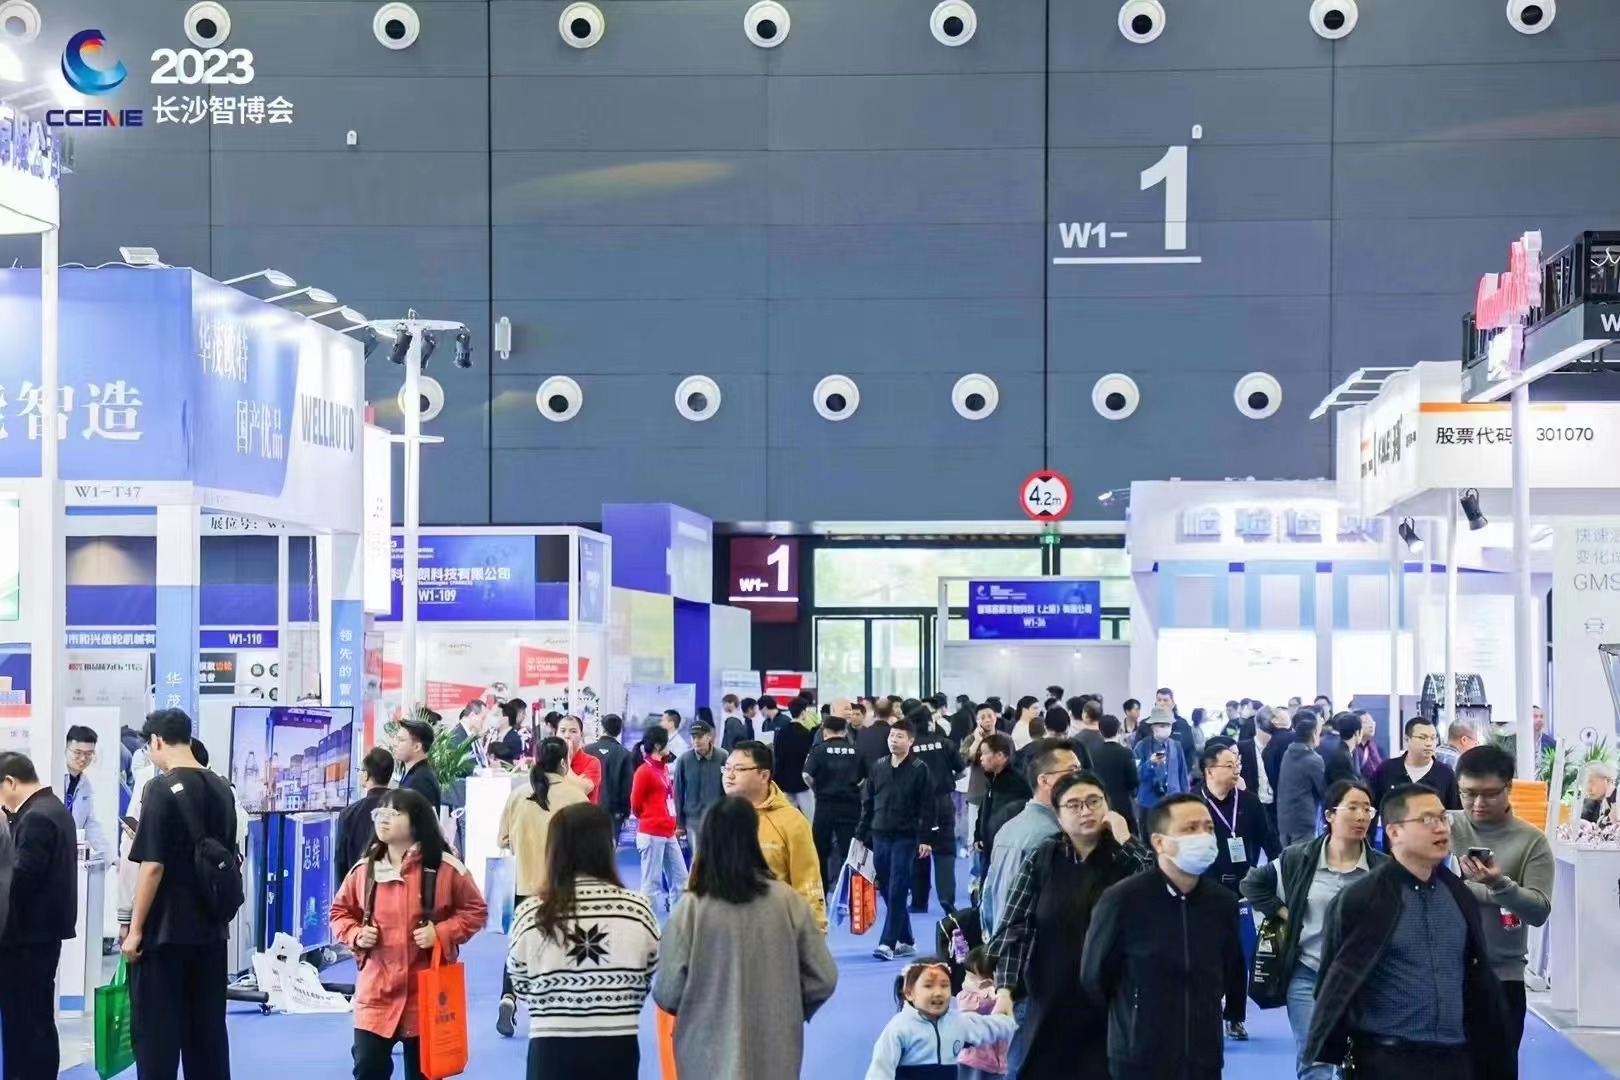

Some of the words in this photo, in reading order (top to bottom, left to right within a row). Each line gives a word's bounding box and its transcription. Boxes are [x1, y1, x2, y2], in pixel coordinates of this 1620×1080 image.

[1059, 222, 1128, 248] W1-
[0, 379, 144, 441] 智造
[301, 391, 355, 452] WELLAUTO
[1536, 427, 1594, 441] 301070
[75, 486, 142, 498] W1-T47
[1029, 485, 1062, 506] 4.2m
[418, 588, 456, 602] W1-109
[229, 633, 262, 645] W1-110
